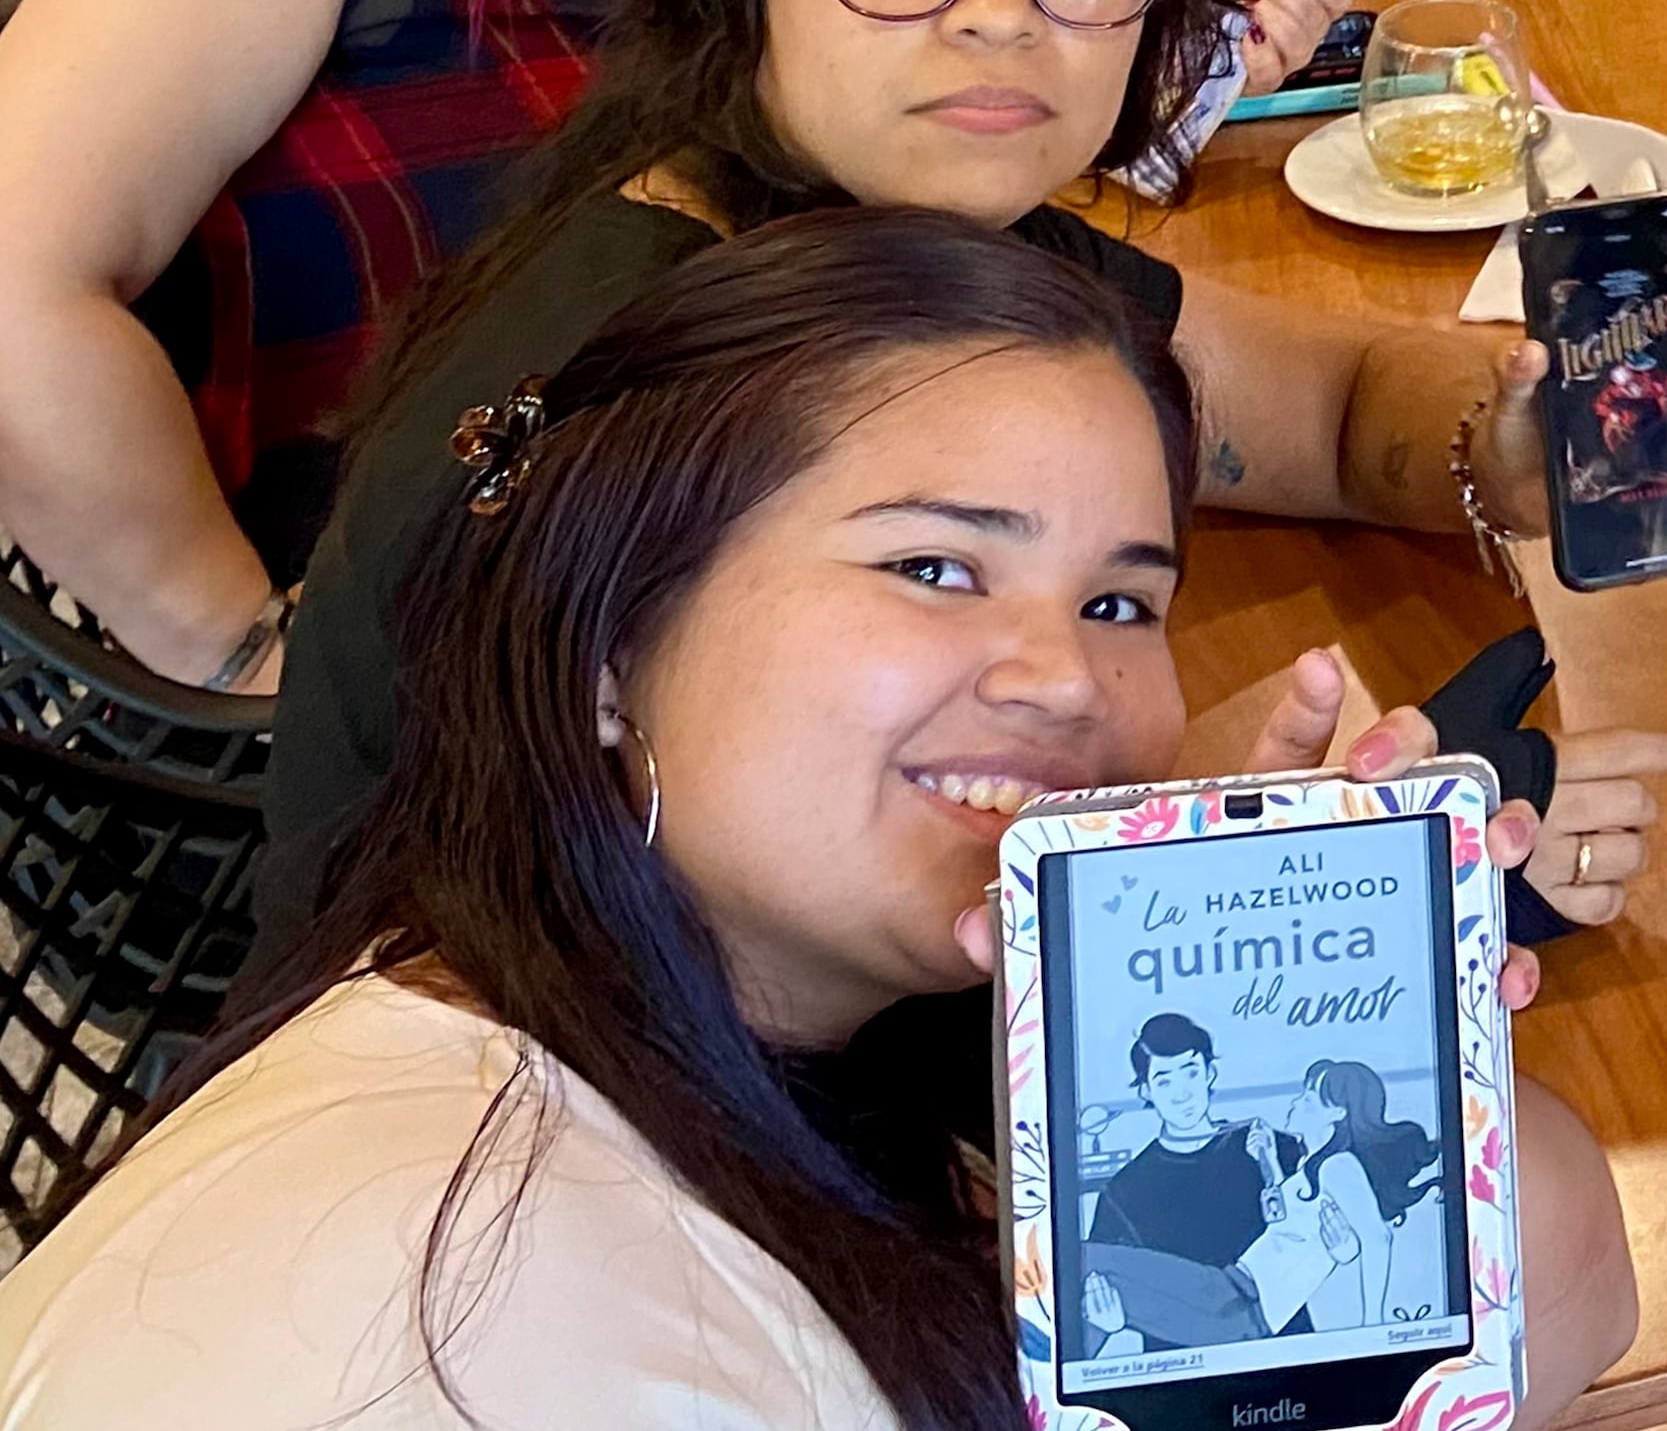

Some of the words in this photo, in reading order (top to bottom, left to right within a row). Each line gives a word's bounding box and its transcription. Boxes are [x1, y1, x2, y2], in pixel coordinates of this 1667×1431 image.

[1277, 851, 1324, 876] ALI
[1143, 889, 1188, 932] La
[1205, 876, 1399, 915] HAZELWOOD
[1127, 918, 1376, 995] química
[1232, 973, 1285, 1020] del
[1286, 975, 1408, 1028] amor
[1190, 1353, 1204, 1365] 21
[1232, 1399, 1307, 1428] kindle
